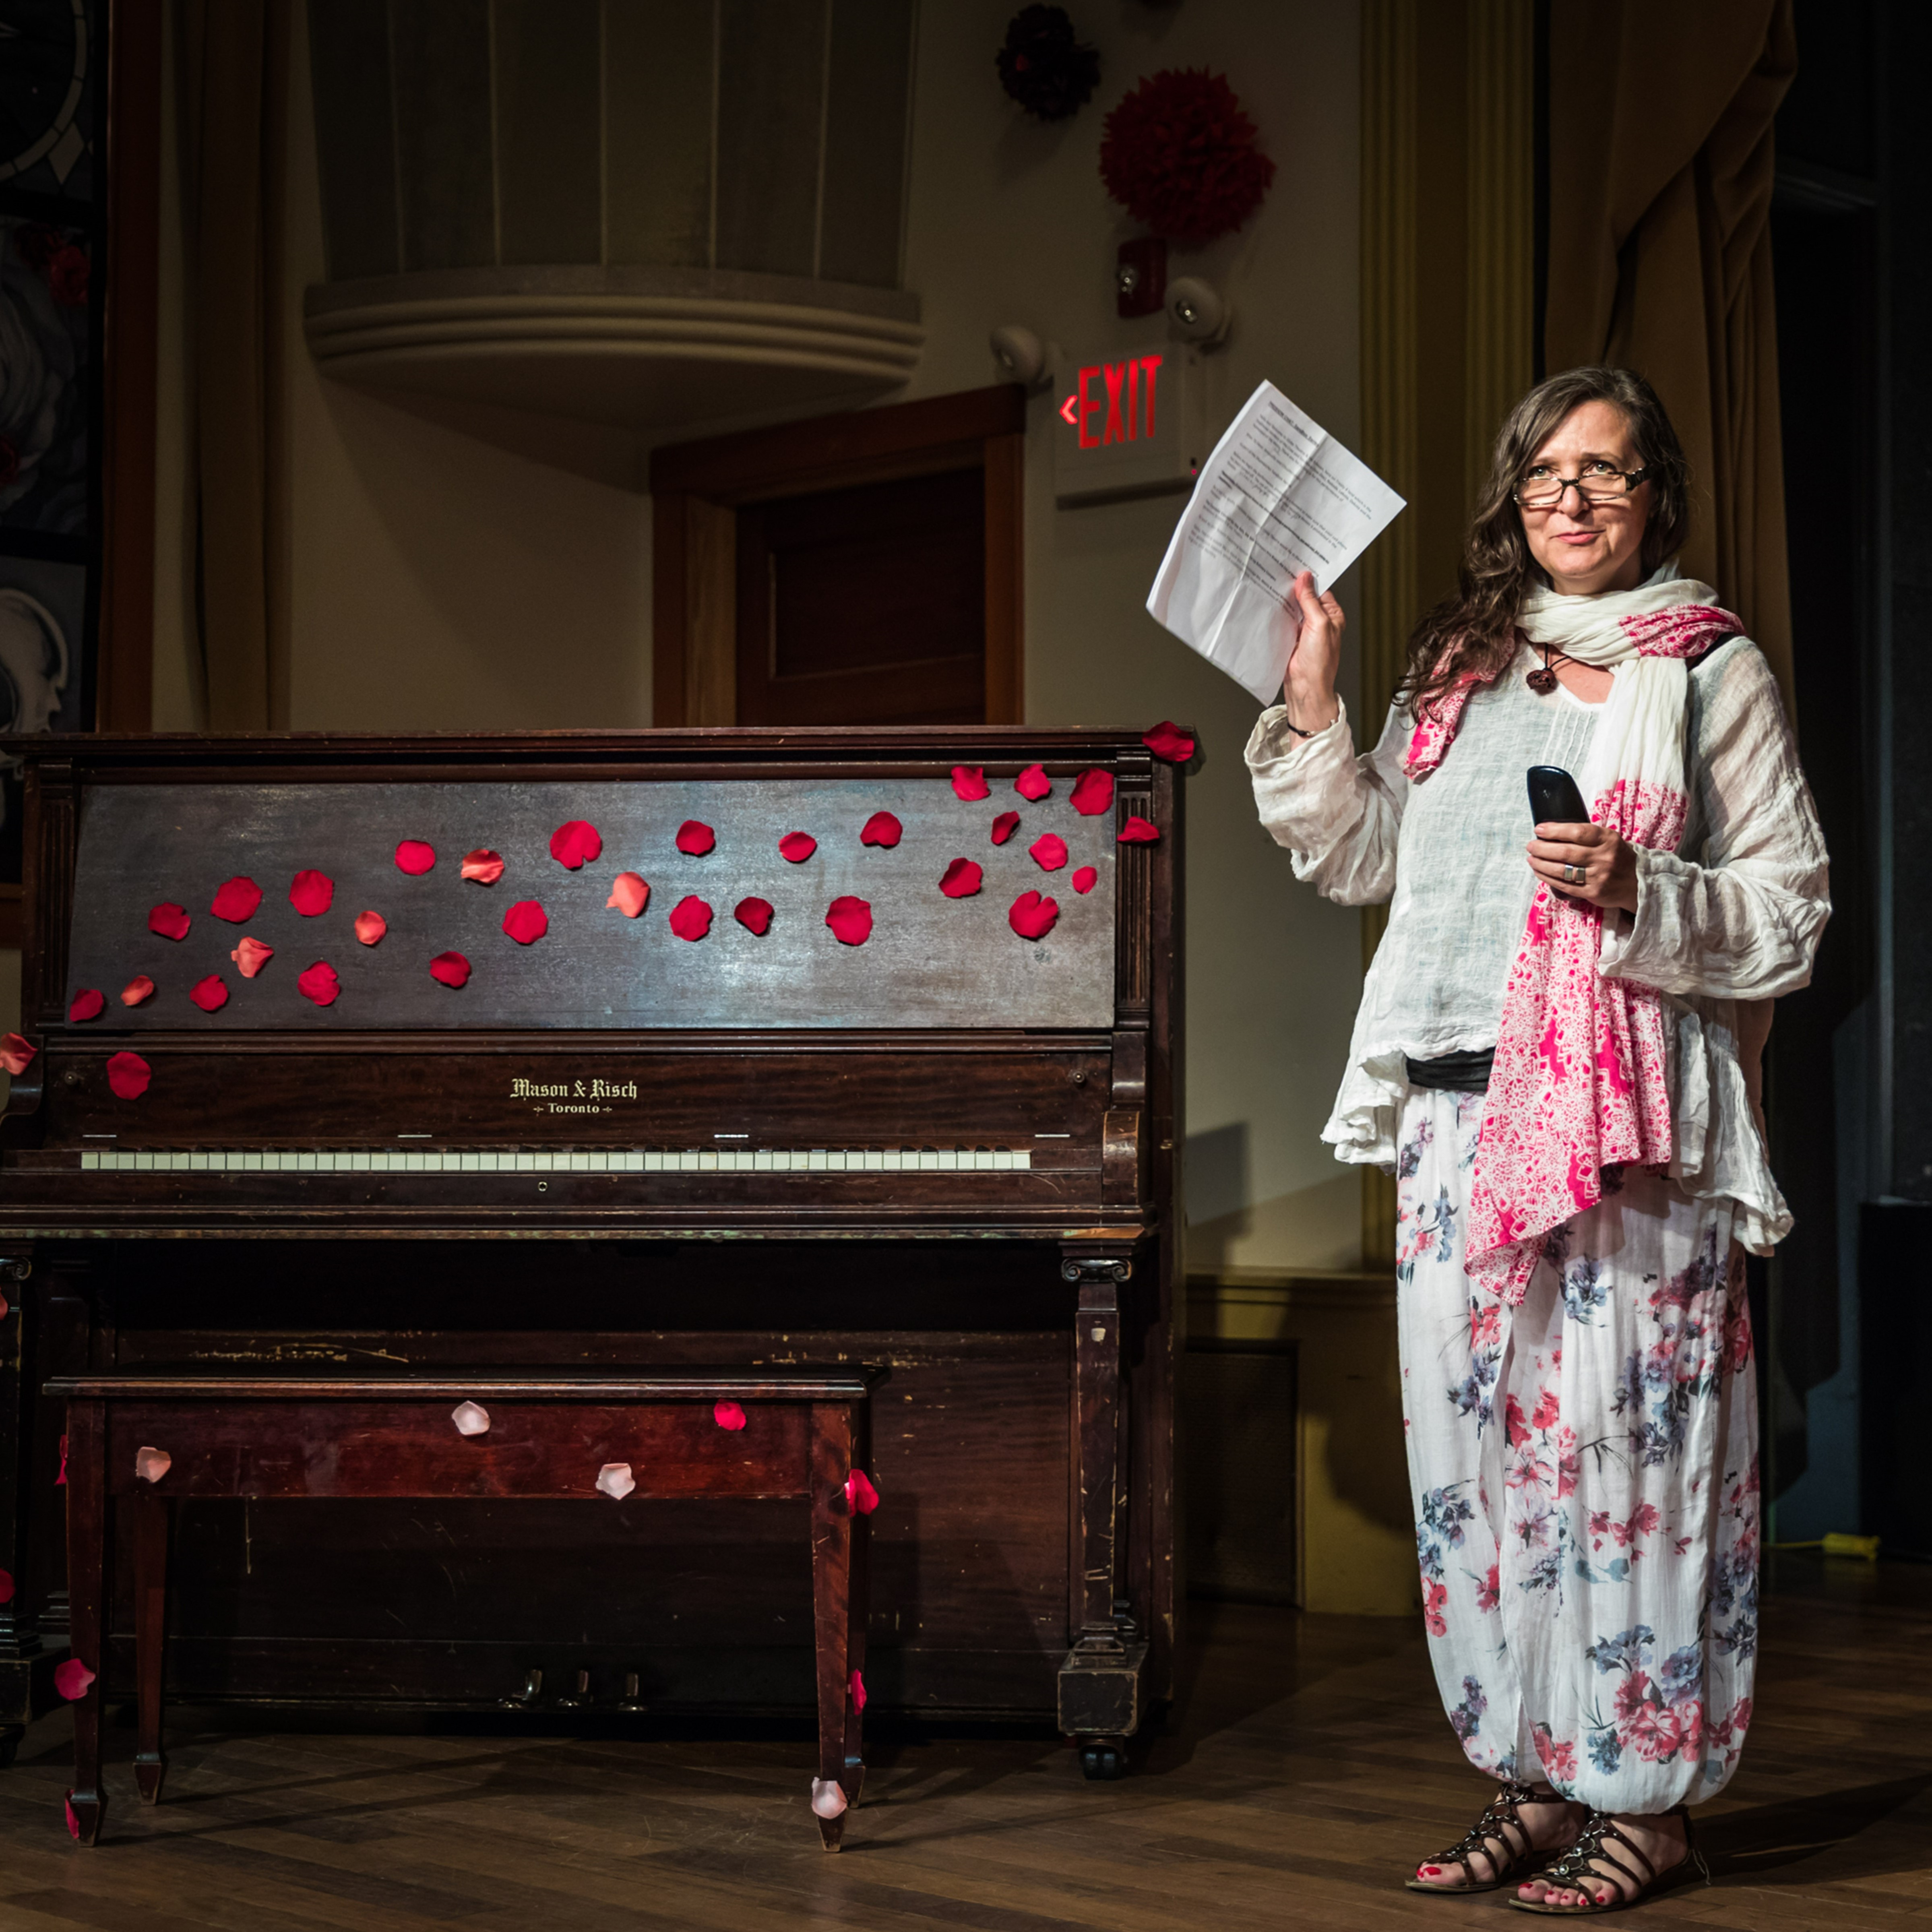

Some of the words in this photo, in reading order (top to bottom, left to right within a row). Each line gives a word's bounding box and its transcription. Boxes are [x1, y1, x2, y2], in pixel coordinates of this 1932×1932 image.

[1079, 355, 1162, 449] EXIT
[510, 1079, 568, 1101] Mason
[573, 1080, 586, 1097] &
[590, 1079, 637, 1101] Risch
[548, 1103, 600, 1114] Toronto
